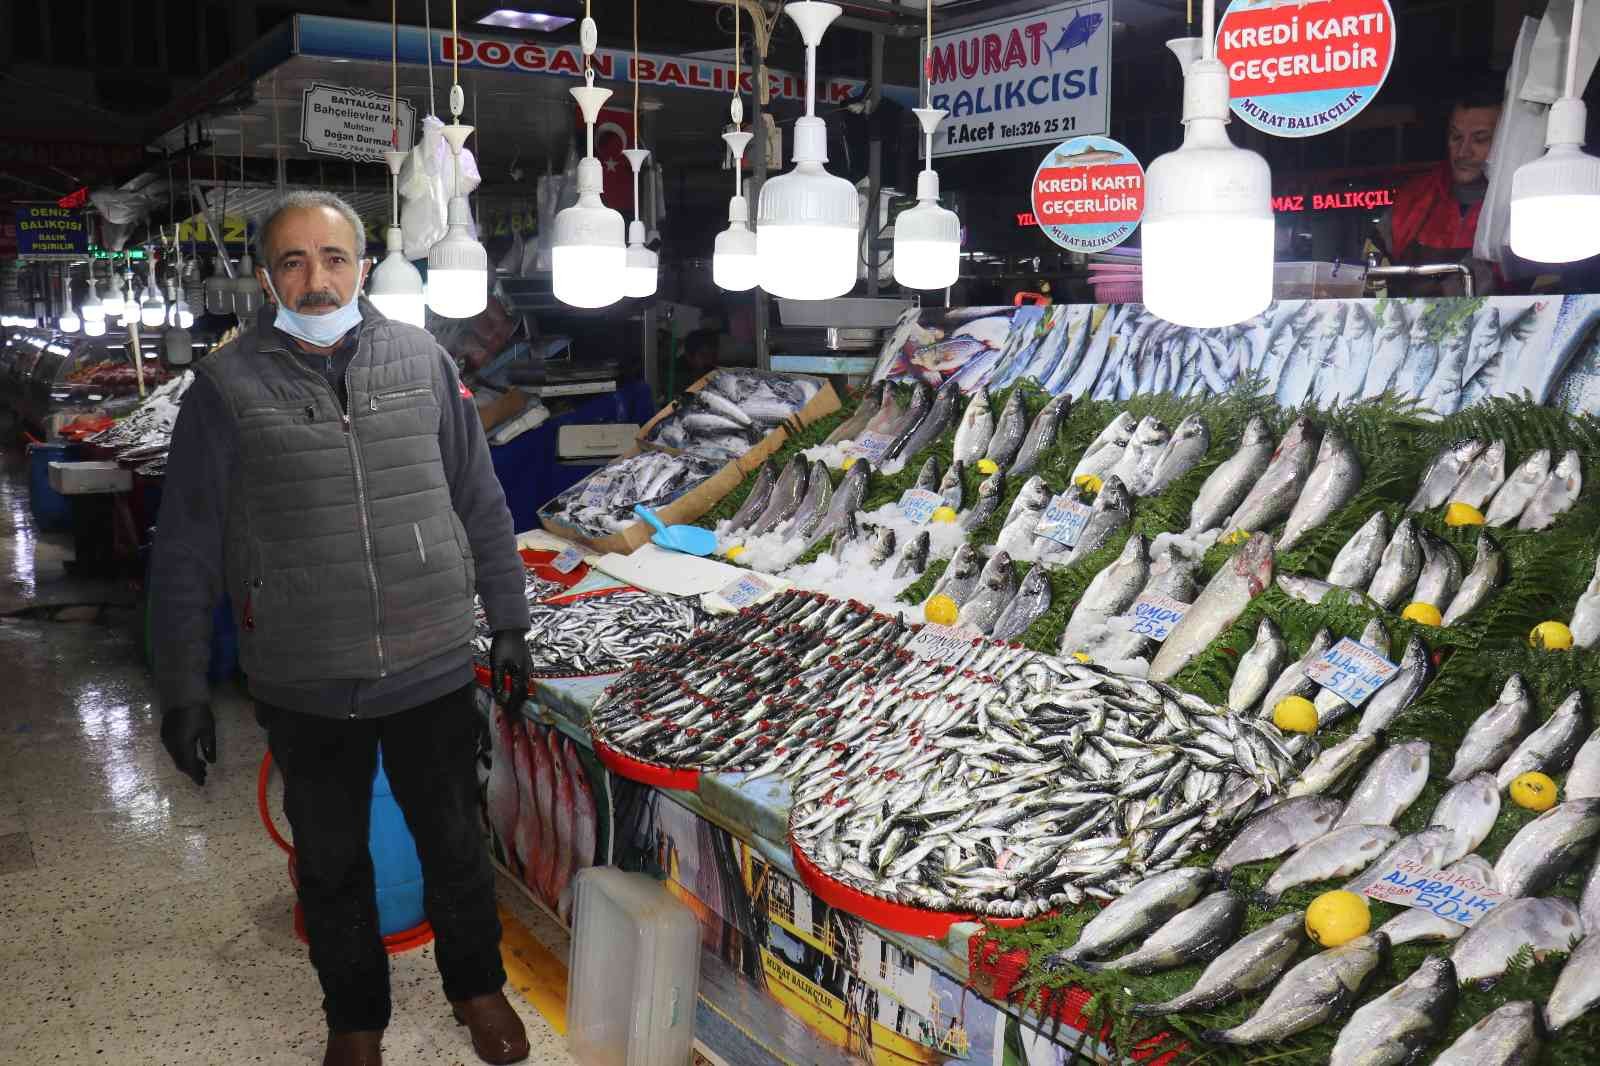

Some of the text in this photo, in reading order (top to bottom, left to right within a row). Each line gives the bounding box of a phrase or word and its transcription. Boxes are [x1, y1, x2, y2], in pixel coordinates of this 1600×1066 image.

[1224, 13, 1384, 50] KREDİ KARTI
[443, 36, 613, 77] DOĞAN
[931, 22, 1047, 85] MURAT
[1229, 42, 1378, 83] GEÇERLİDİR
[1240, 90, 1363, 129] MURAT BALIKÇILIK
[947, 122, 995, 145] F.Acet
[1044, 118, 1059, 133] 25
[1062, 116, 1076, 131] 21
[1039, 174, 1141, 193] KREDİ KARTI
[1312, 190, 1394, 209] BALIKÇIL
[1042, 194, 1138, 216] GEÇERLİDİR
[1051, 226, 1081, 247] MURAT
[1382, 869, 1497, 912] ALABALIK
[766, 955, 791, 981] MURAT
